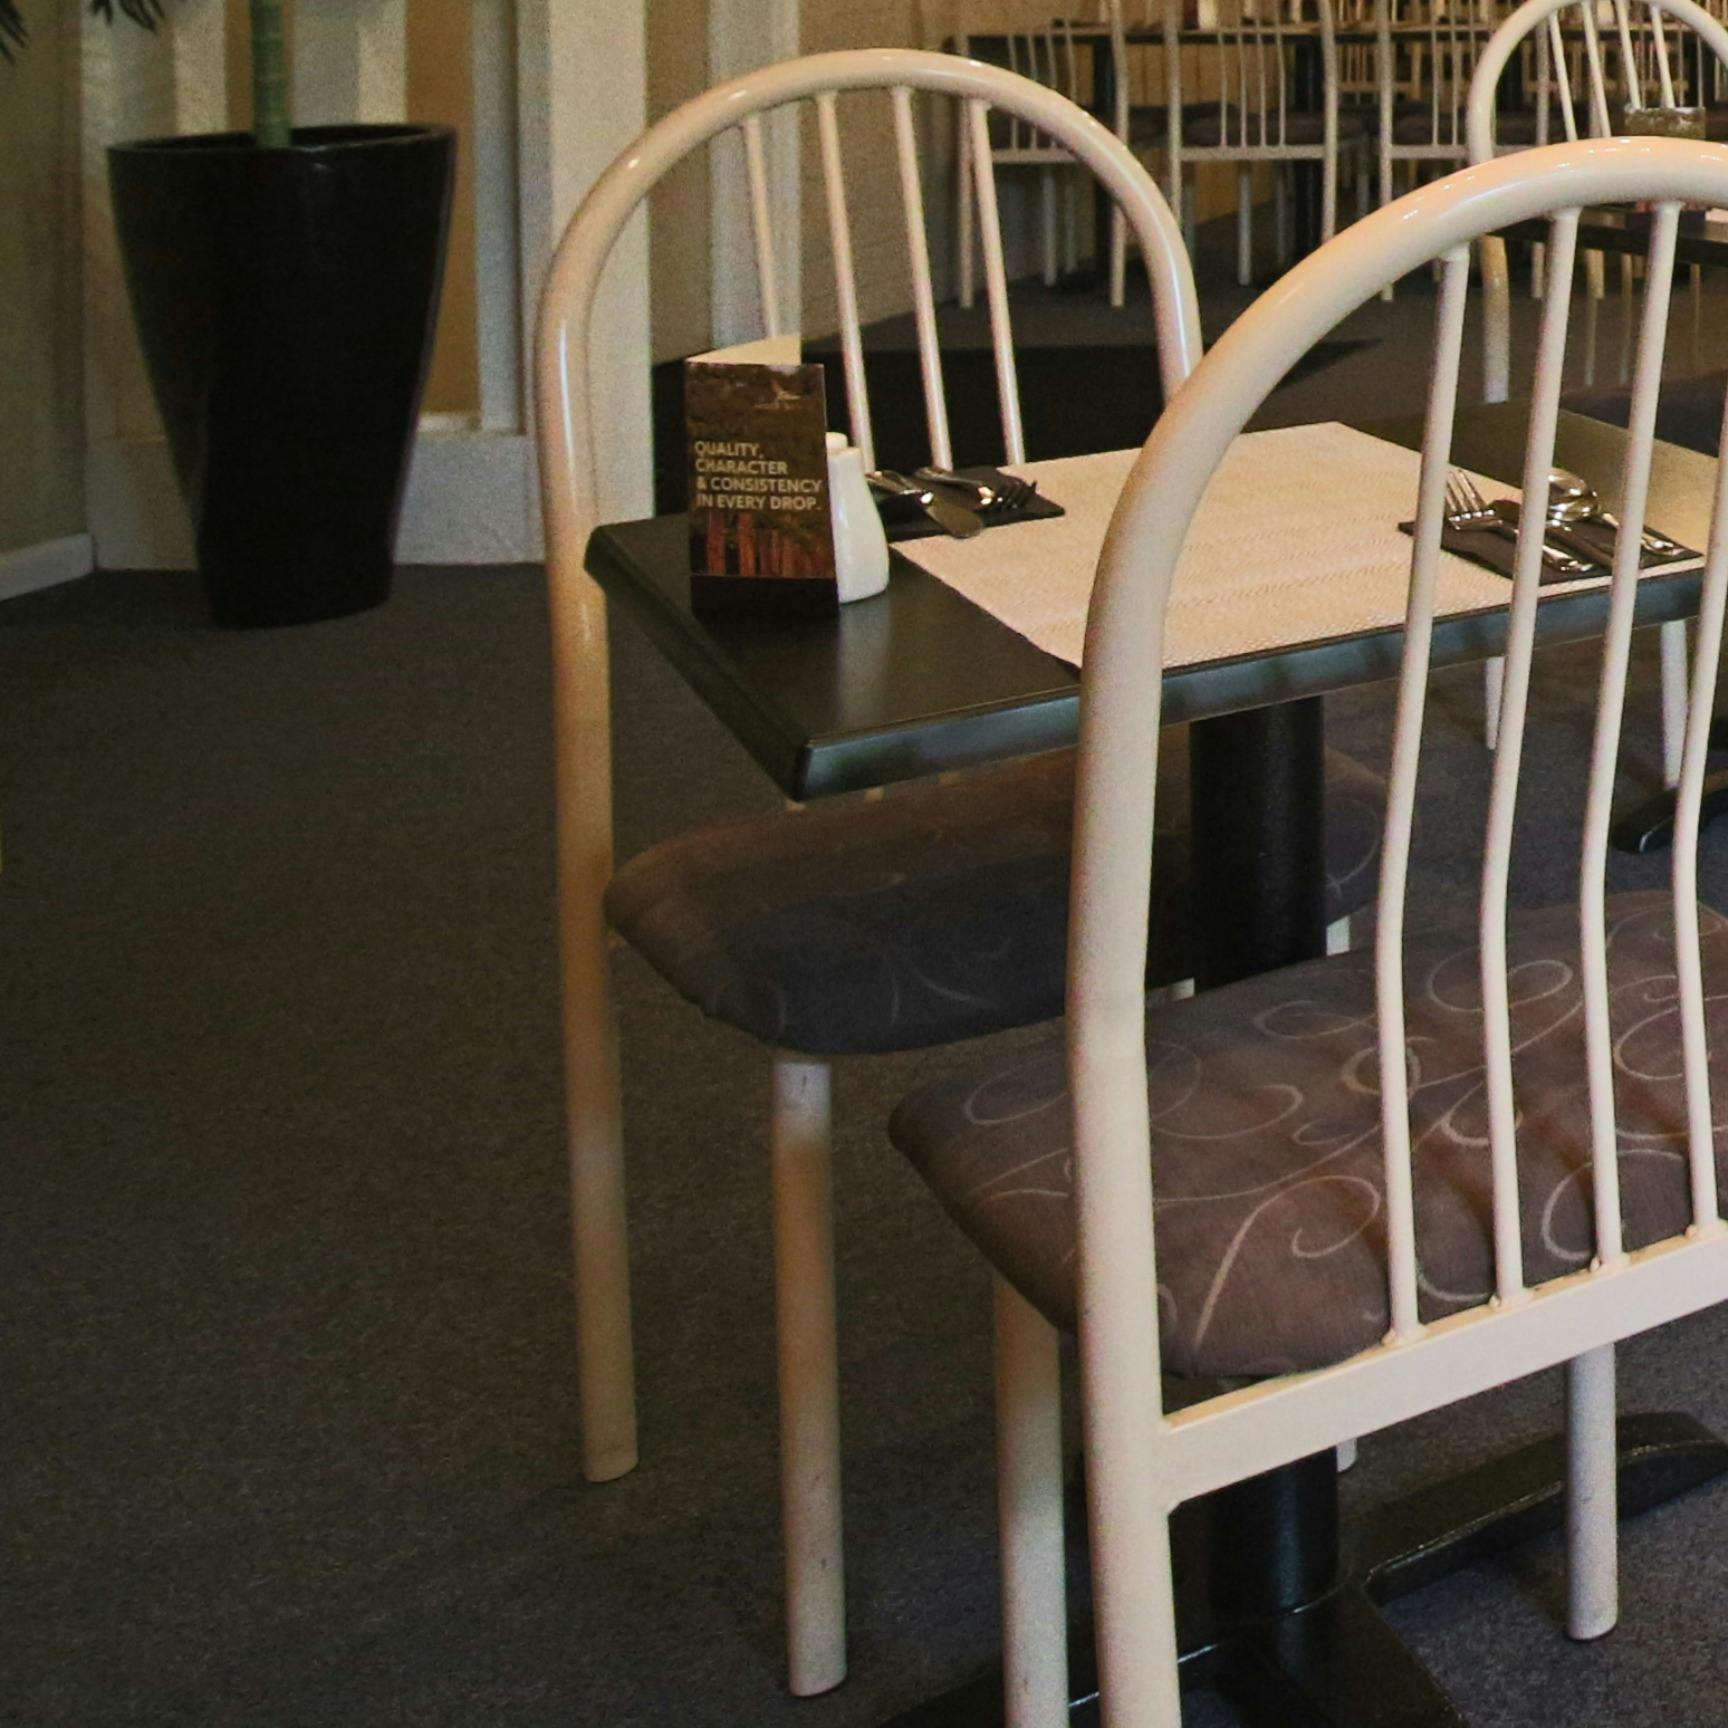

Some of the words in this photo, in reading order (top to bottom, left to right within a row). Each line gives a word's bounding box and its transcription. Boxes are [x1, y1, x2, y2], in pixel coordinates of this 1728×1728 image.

[695, 459, 788, 474] CHARACTER
[697, 475, 706, 490] &
[711, 477, 822, 492] CONSISTENCY
[698, 493, 713, 507] IN
[718, 494, 766, 509] EVERY
[770, 496, 822, 511] DROP.
